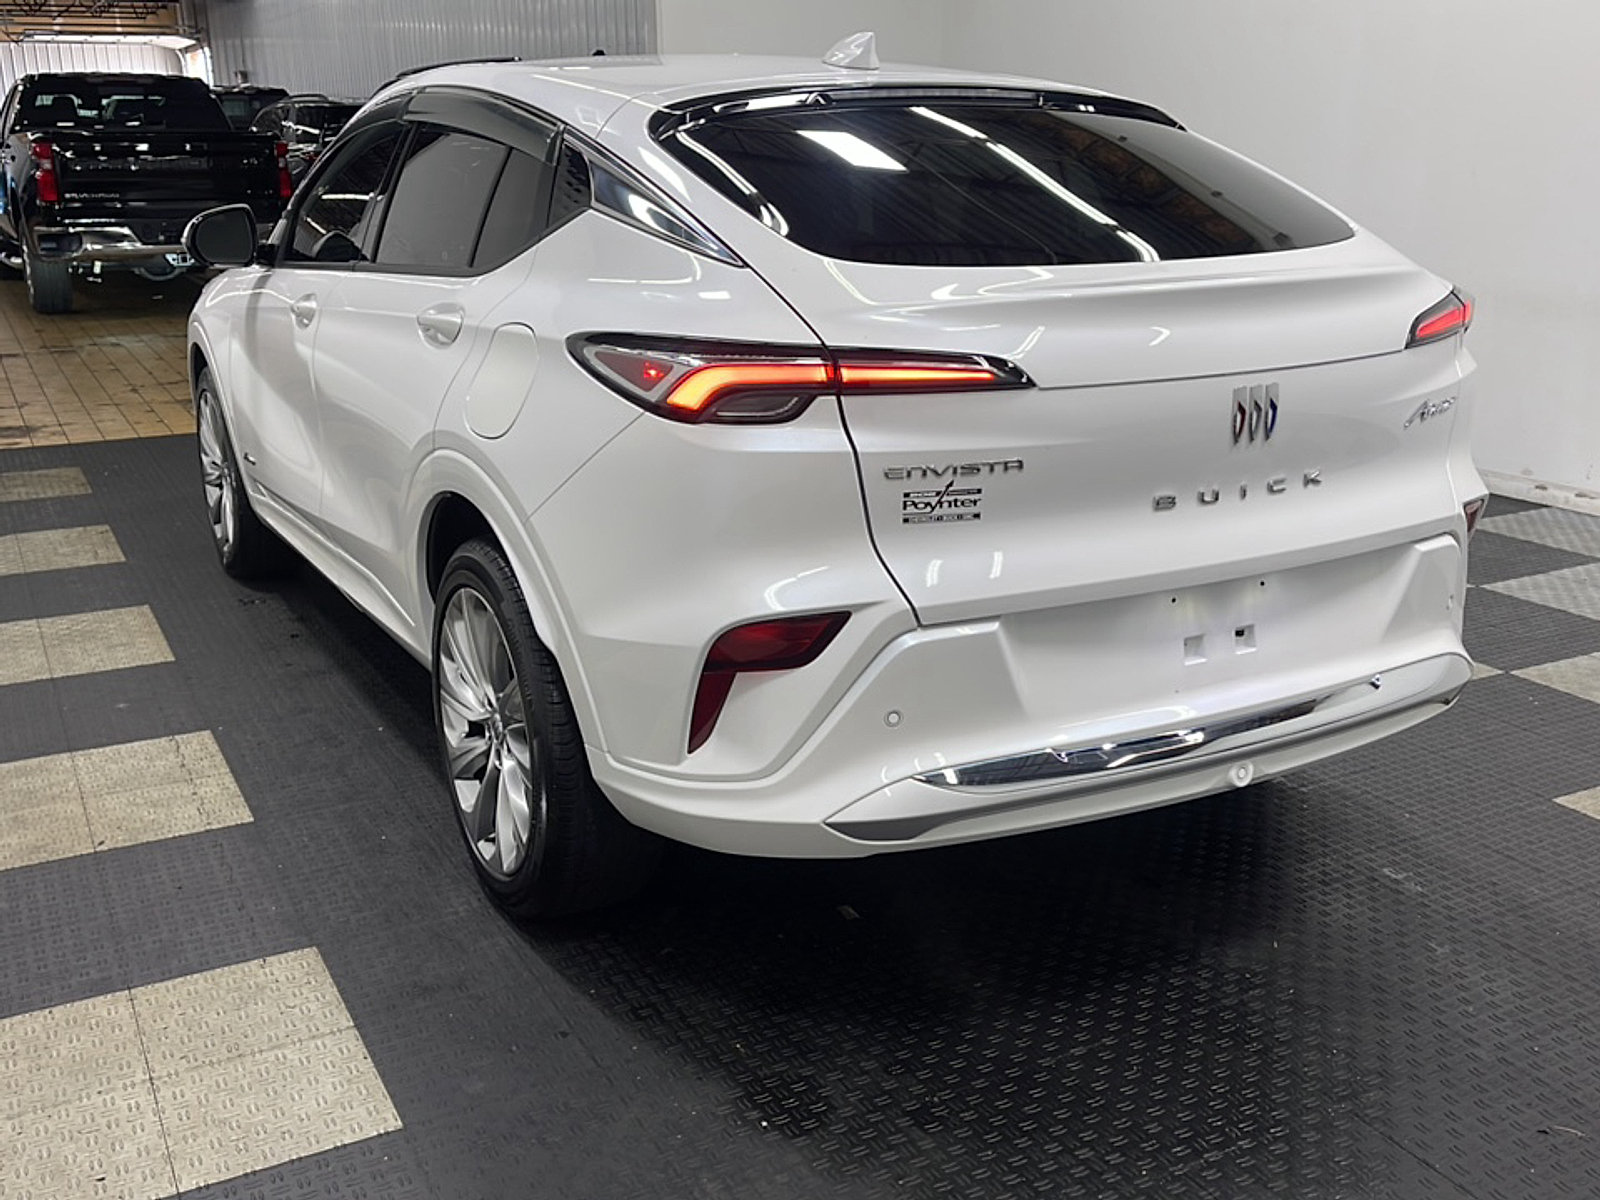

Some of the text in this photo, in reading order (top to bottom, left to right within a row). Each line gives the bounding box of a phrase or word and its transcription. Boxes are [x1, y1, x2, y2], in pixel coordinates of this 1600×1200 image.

[884, 458, 1024, 480] ENVISTA
[1152, 467, 1323, 512] BUICK
[902, 497, 982, 513] Poynter
